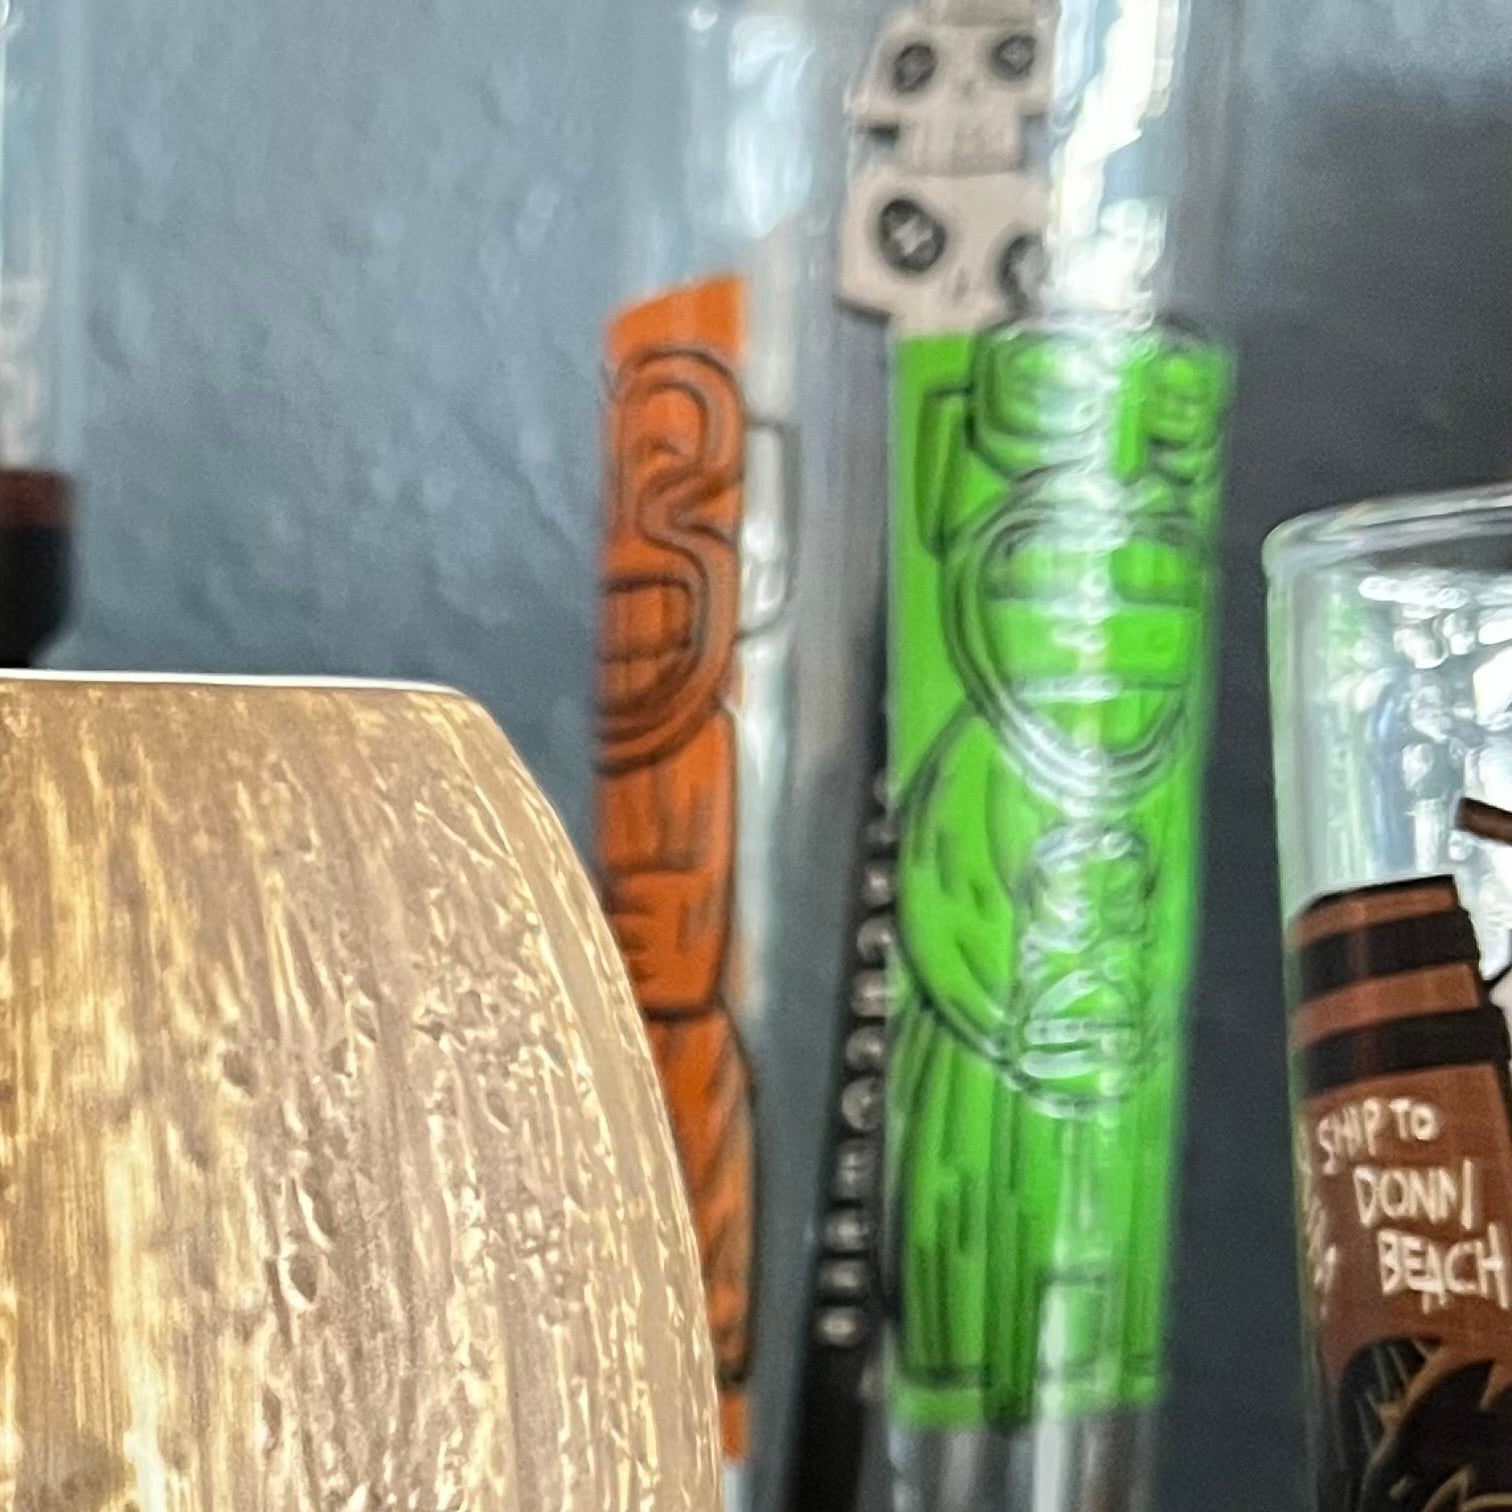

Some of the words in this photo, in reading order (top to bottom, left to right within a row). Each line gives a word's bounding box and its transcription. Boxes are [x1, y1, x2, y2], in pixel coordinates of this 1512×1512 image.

[1317, 1097, 1380, 1175] SHIP
[1389, 1098, 1437, 1141] TO
[1378, 1222, 1510, 1314] BEACH
